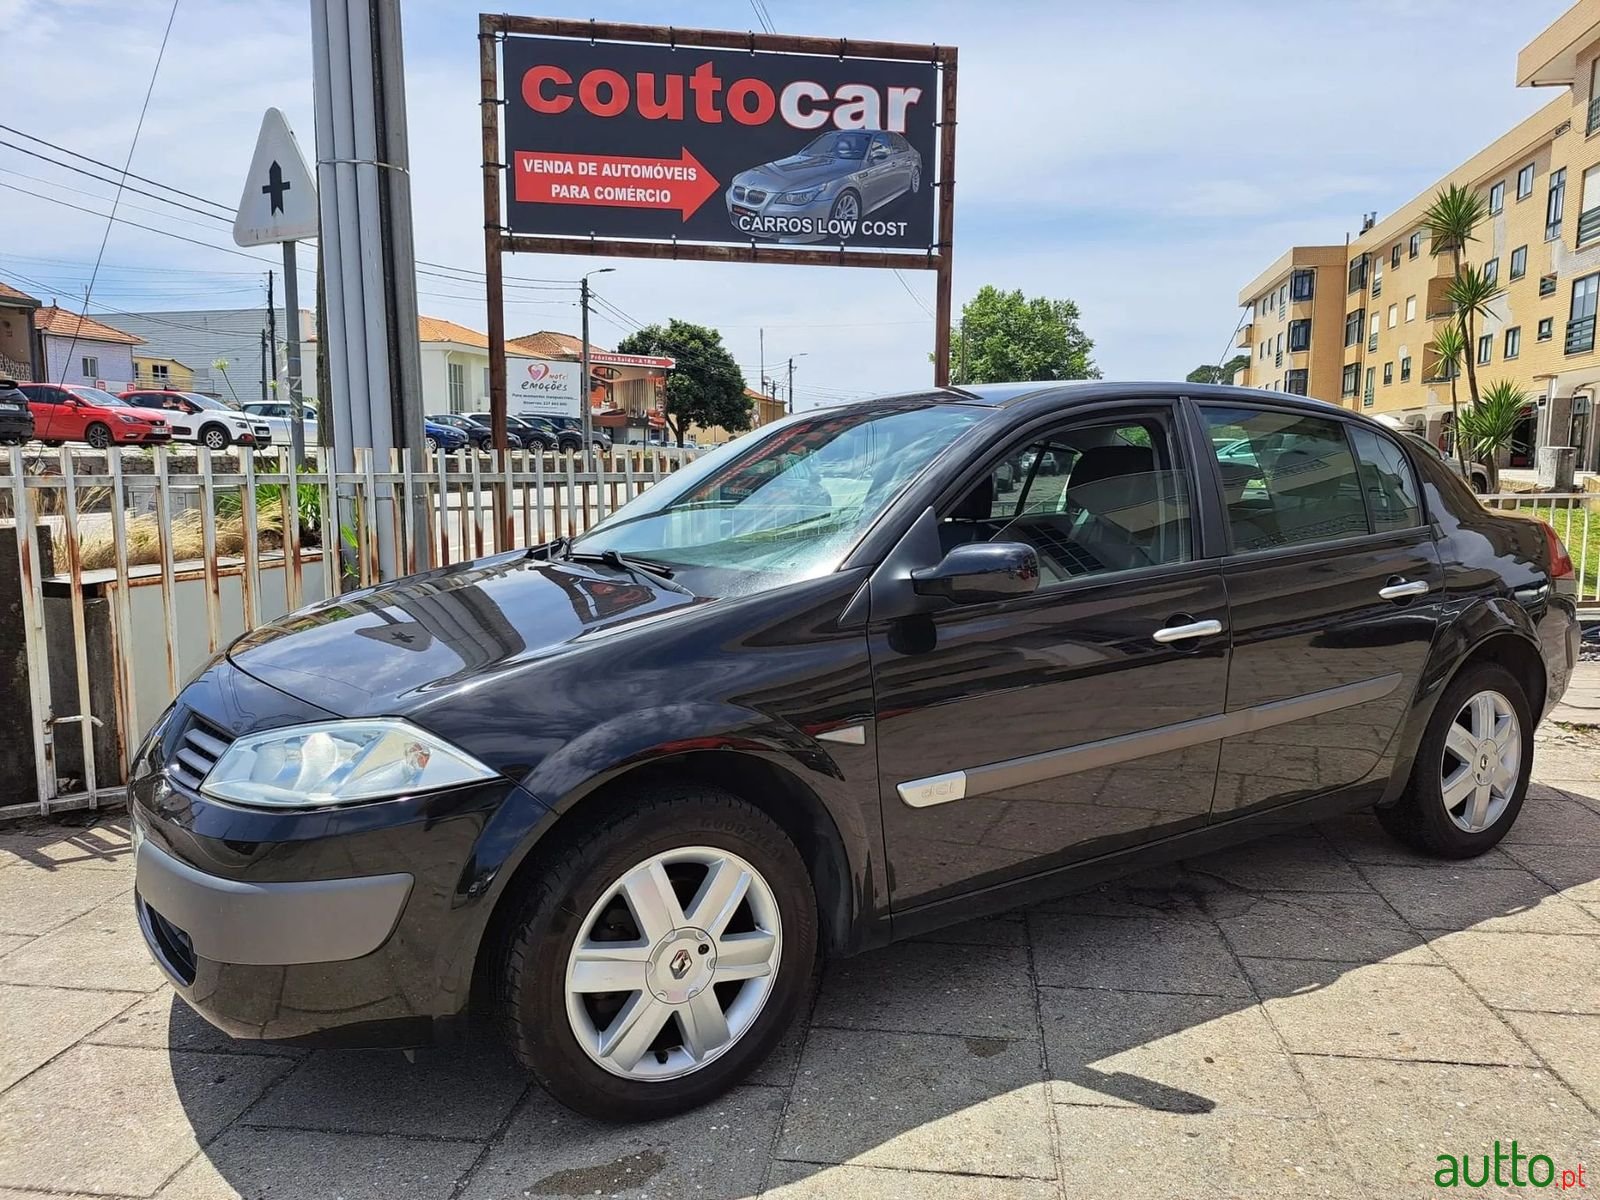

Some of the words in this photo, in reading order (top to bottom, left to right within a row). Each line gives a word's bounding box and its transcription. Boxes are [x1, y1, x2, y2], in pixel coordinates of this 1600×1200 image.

[521, 61, 923, 133] coutocar
[523, 158, 574, 175] VENDA
[578, 161, 597, 176] DE
[601, 162, 697, 181] AUTOMÓVEIS
[551, 184, 590, 199] PARA
[594, 185, 671, 203] COMÉRCIO
[739, 215, 813, 233] CARROS
[818, 219, 857, 235] LOW
[861, 220, 908, 236] COST
[521, 380, 568, 392] emoções
